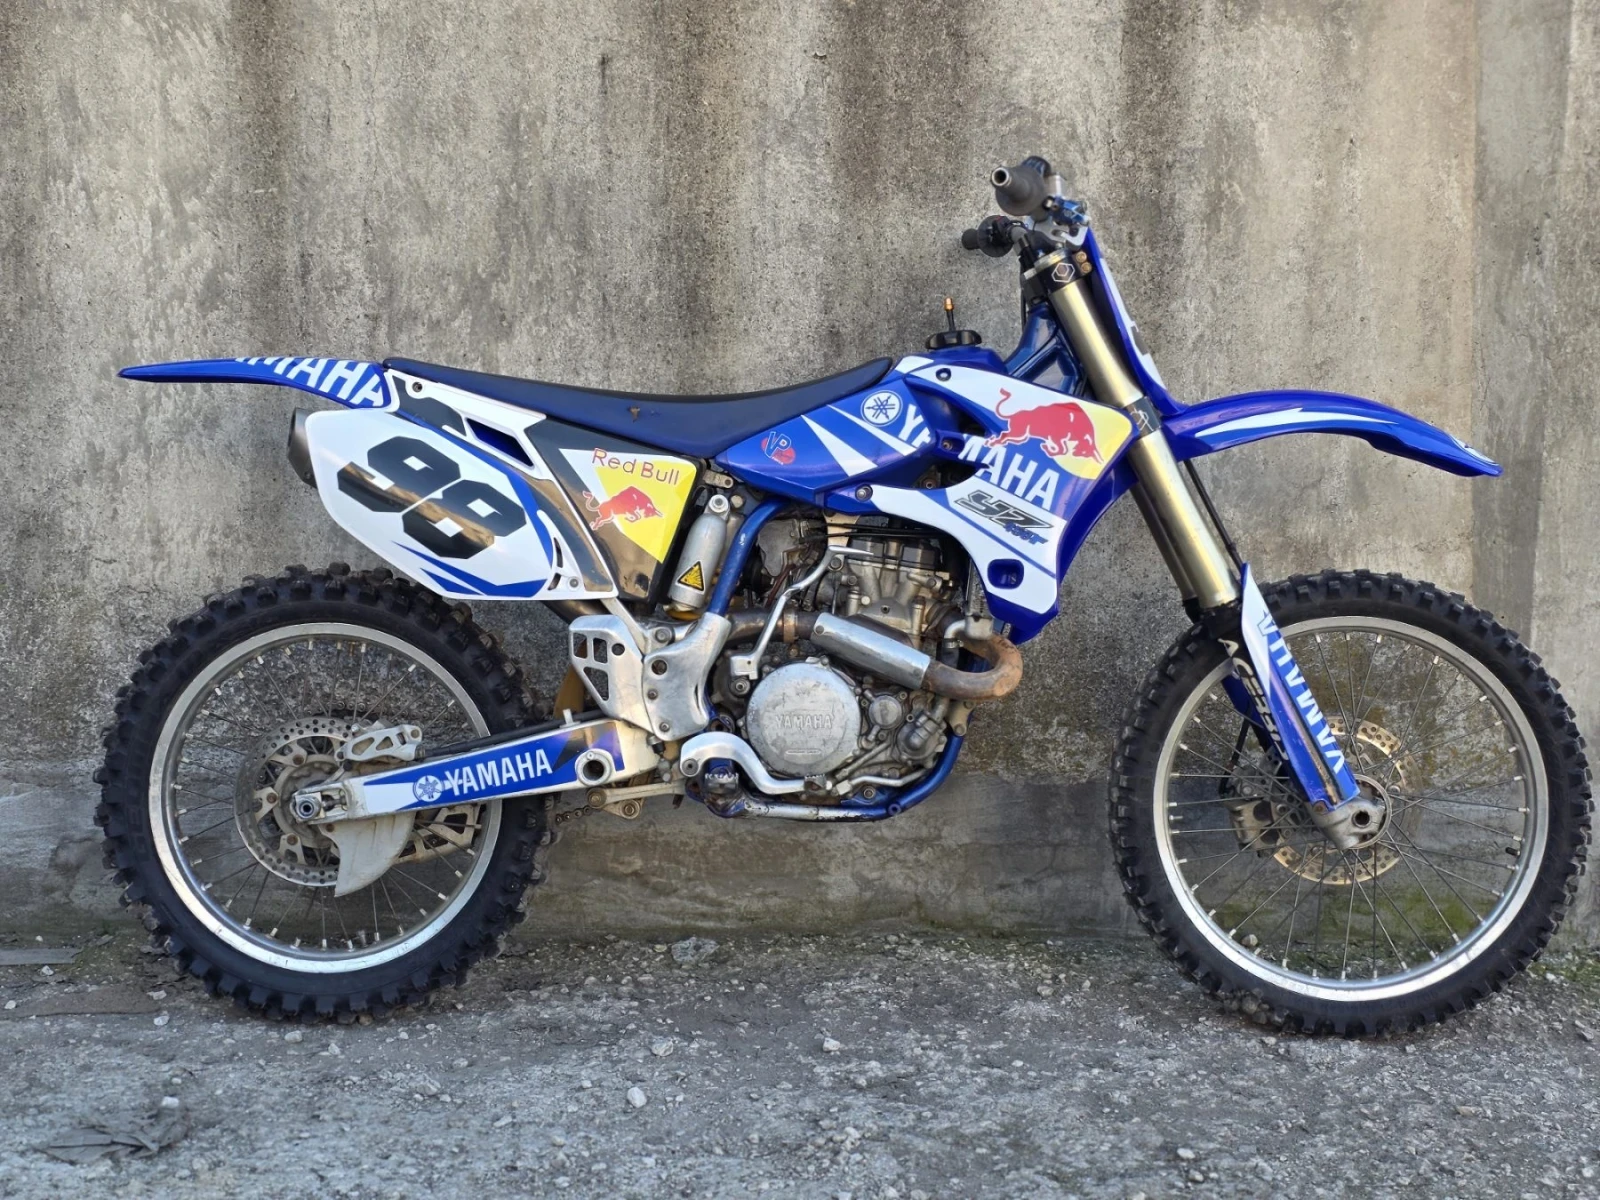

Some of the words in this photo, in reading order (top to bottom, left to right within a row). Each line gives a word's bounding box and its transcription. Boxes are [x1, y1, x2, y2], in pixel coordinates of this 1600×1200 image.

[592, 447, 637, 474] Red
[640, 461, 680, 486] Bull
[337, 435, 527, 560] 98
[953, 489, 1055, 530] YZ
[775, 714, 832, 729] YAMAHA
[444, 748, 553, 797] YAMAHA
